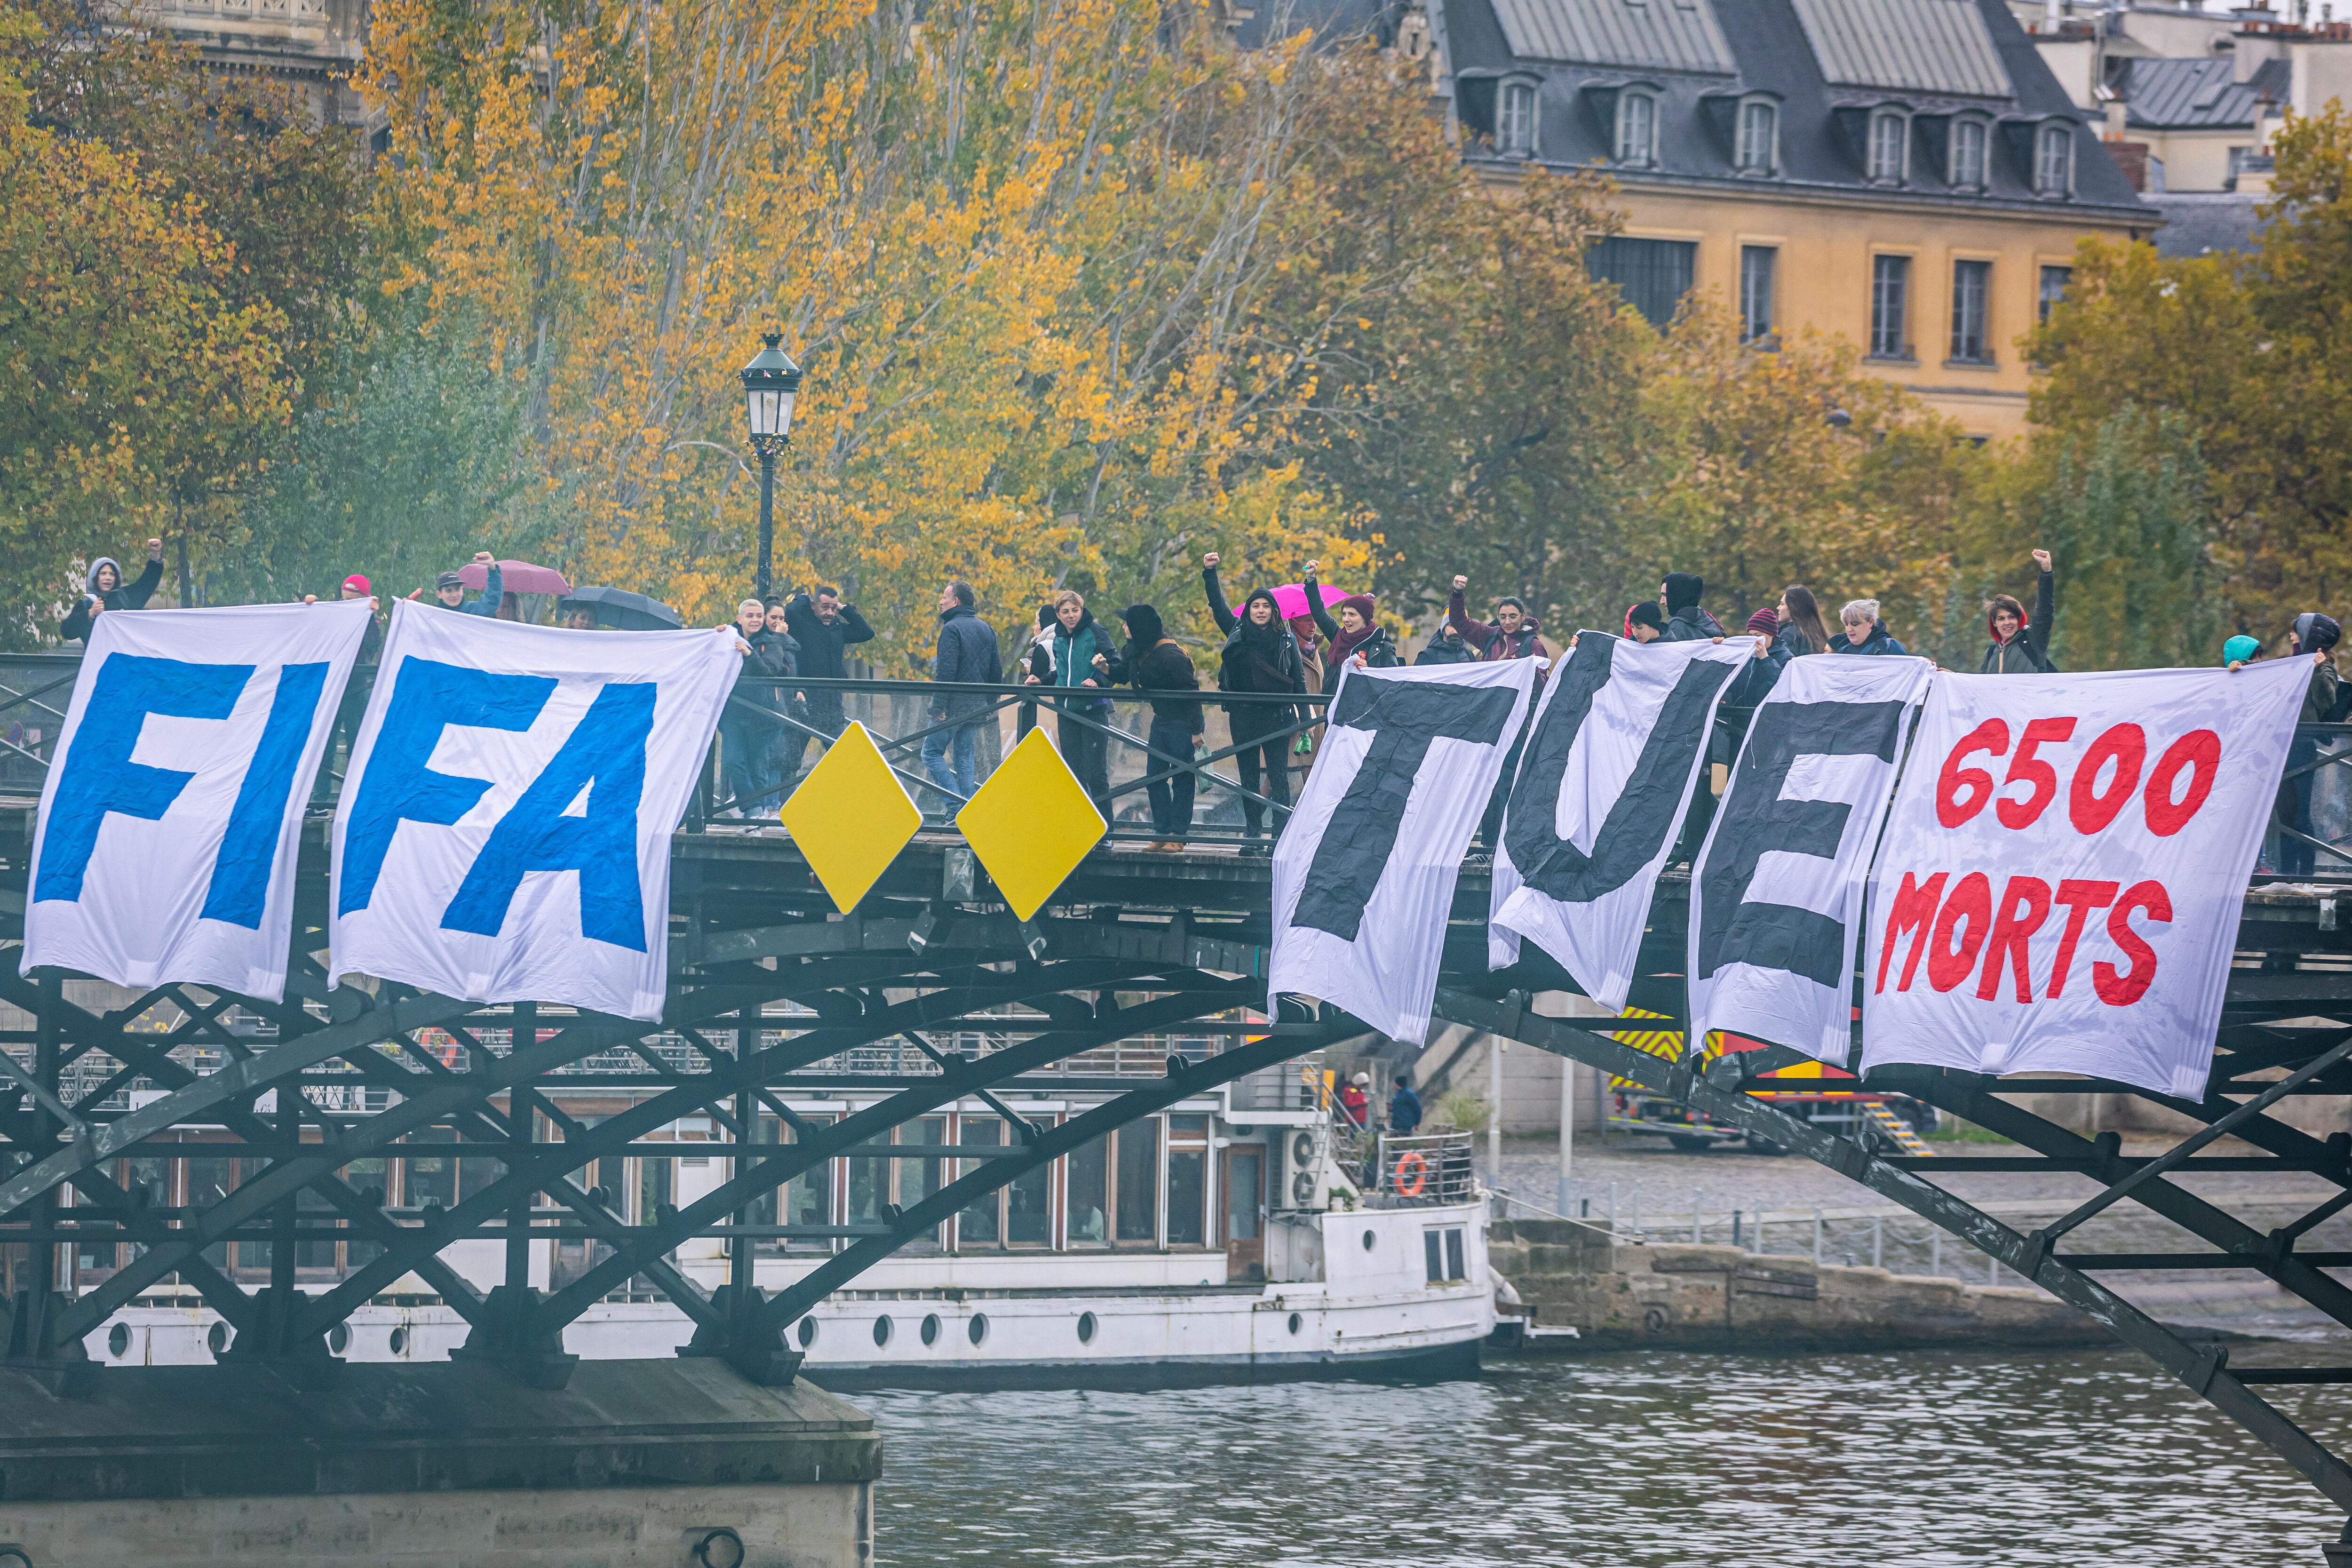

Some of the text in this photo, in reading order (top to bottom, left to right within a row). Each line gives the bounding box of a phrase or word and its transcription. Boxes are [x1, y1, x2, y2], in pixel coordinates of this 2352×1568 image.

[34, 653, 656, 953] FIFA
[1291, 631, 1906, 988] TUE
[1937, 717, 2220, 836] 6500
[1876, 872, 2172, 1005] MORTS
